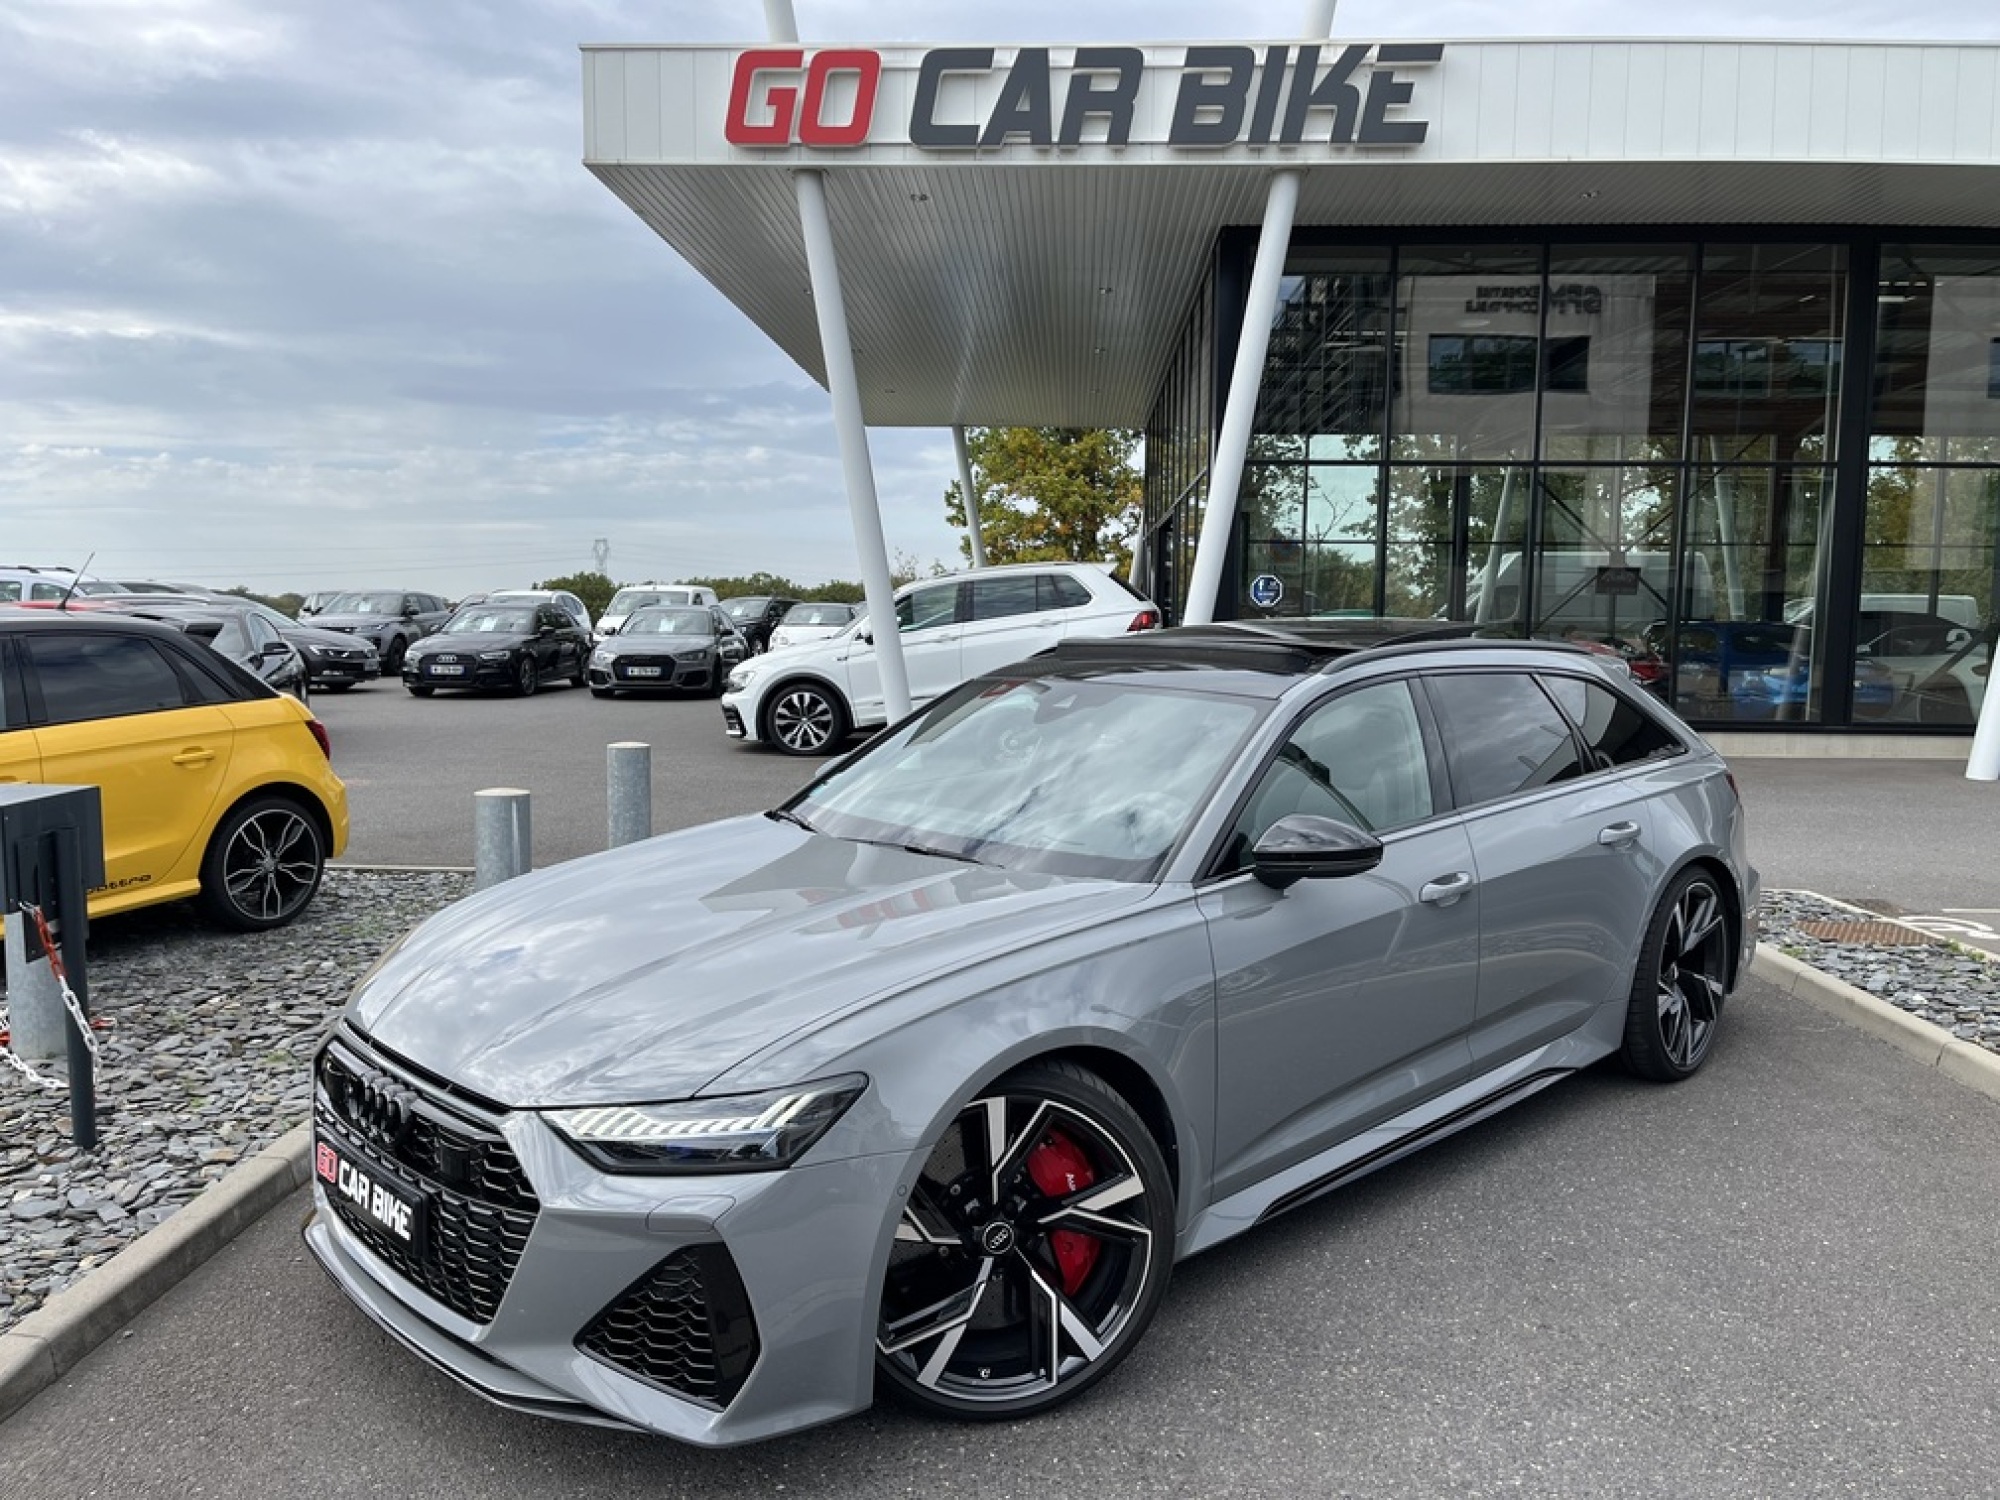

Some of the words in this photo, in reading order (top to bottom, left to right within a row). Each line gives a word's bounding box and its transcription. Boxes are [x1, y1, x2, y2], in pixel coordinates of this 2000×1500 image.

[725, 49, 882, 147] GO
[908, 47, 1144, 147] CAR
[1168, 44, 1445, 147] BIKE
[317, 1142, 338, 1184] GO
[339, 1159, 370, 1210] CAR
[372, 1183, 412, 1240] BIKE
